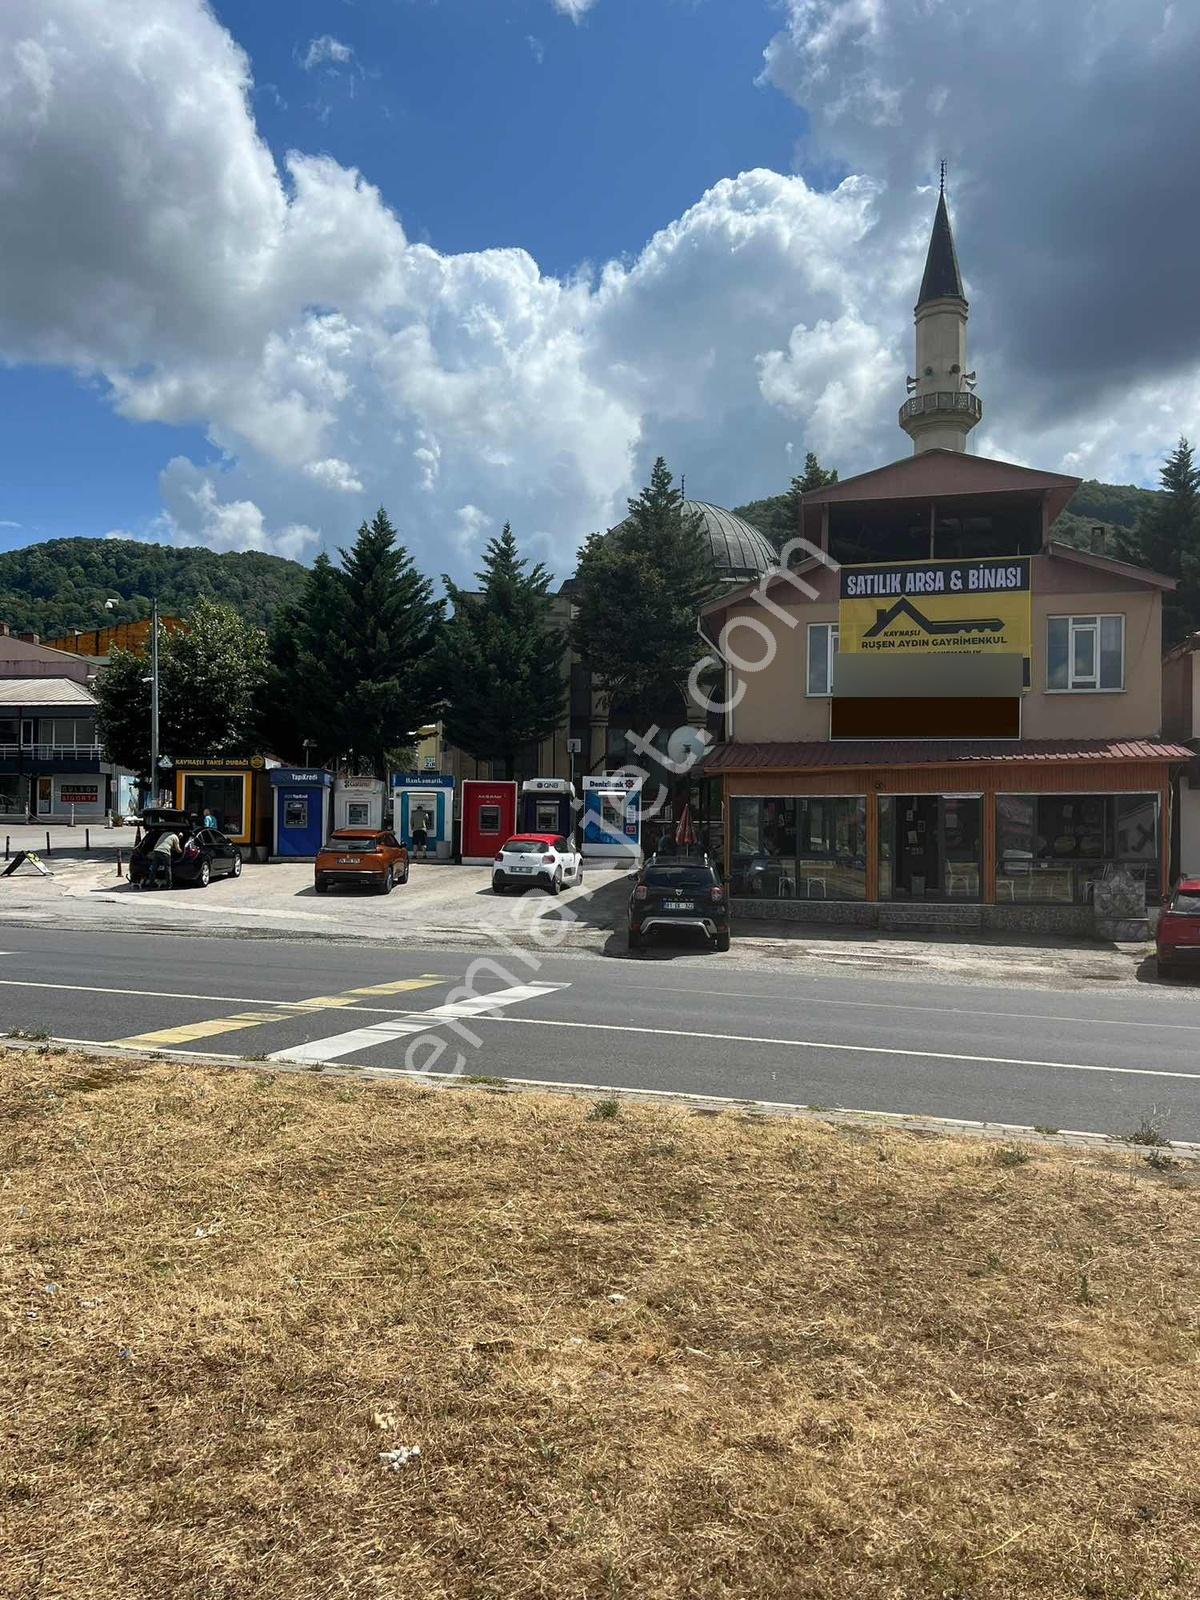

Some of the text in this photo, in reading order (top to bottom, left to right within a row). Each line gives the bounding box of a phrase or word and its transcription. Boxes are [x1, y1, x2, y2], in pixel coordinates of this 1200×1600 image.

[847, 564, 1022, 595] SATILIK ARSA & BİNASI
[861, 635, 1008, 650] RUŞEN AYDIN GAYRİMENKUL
